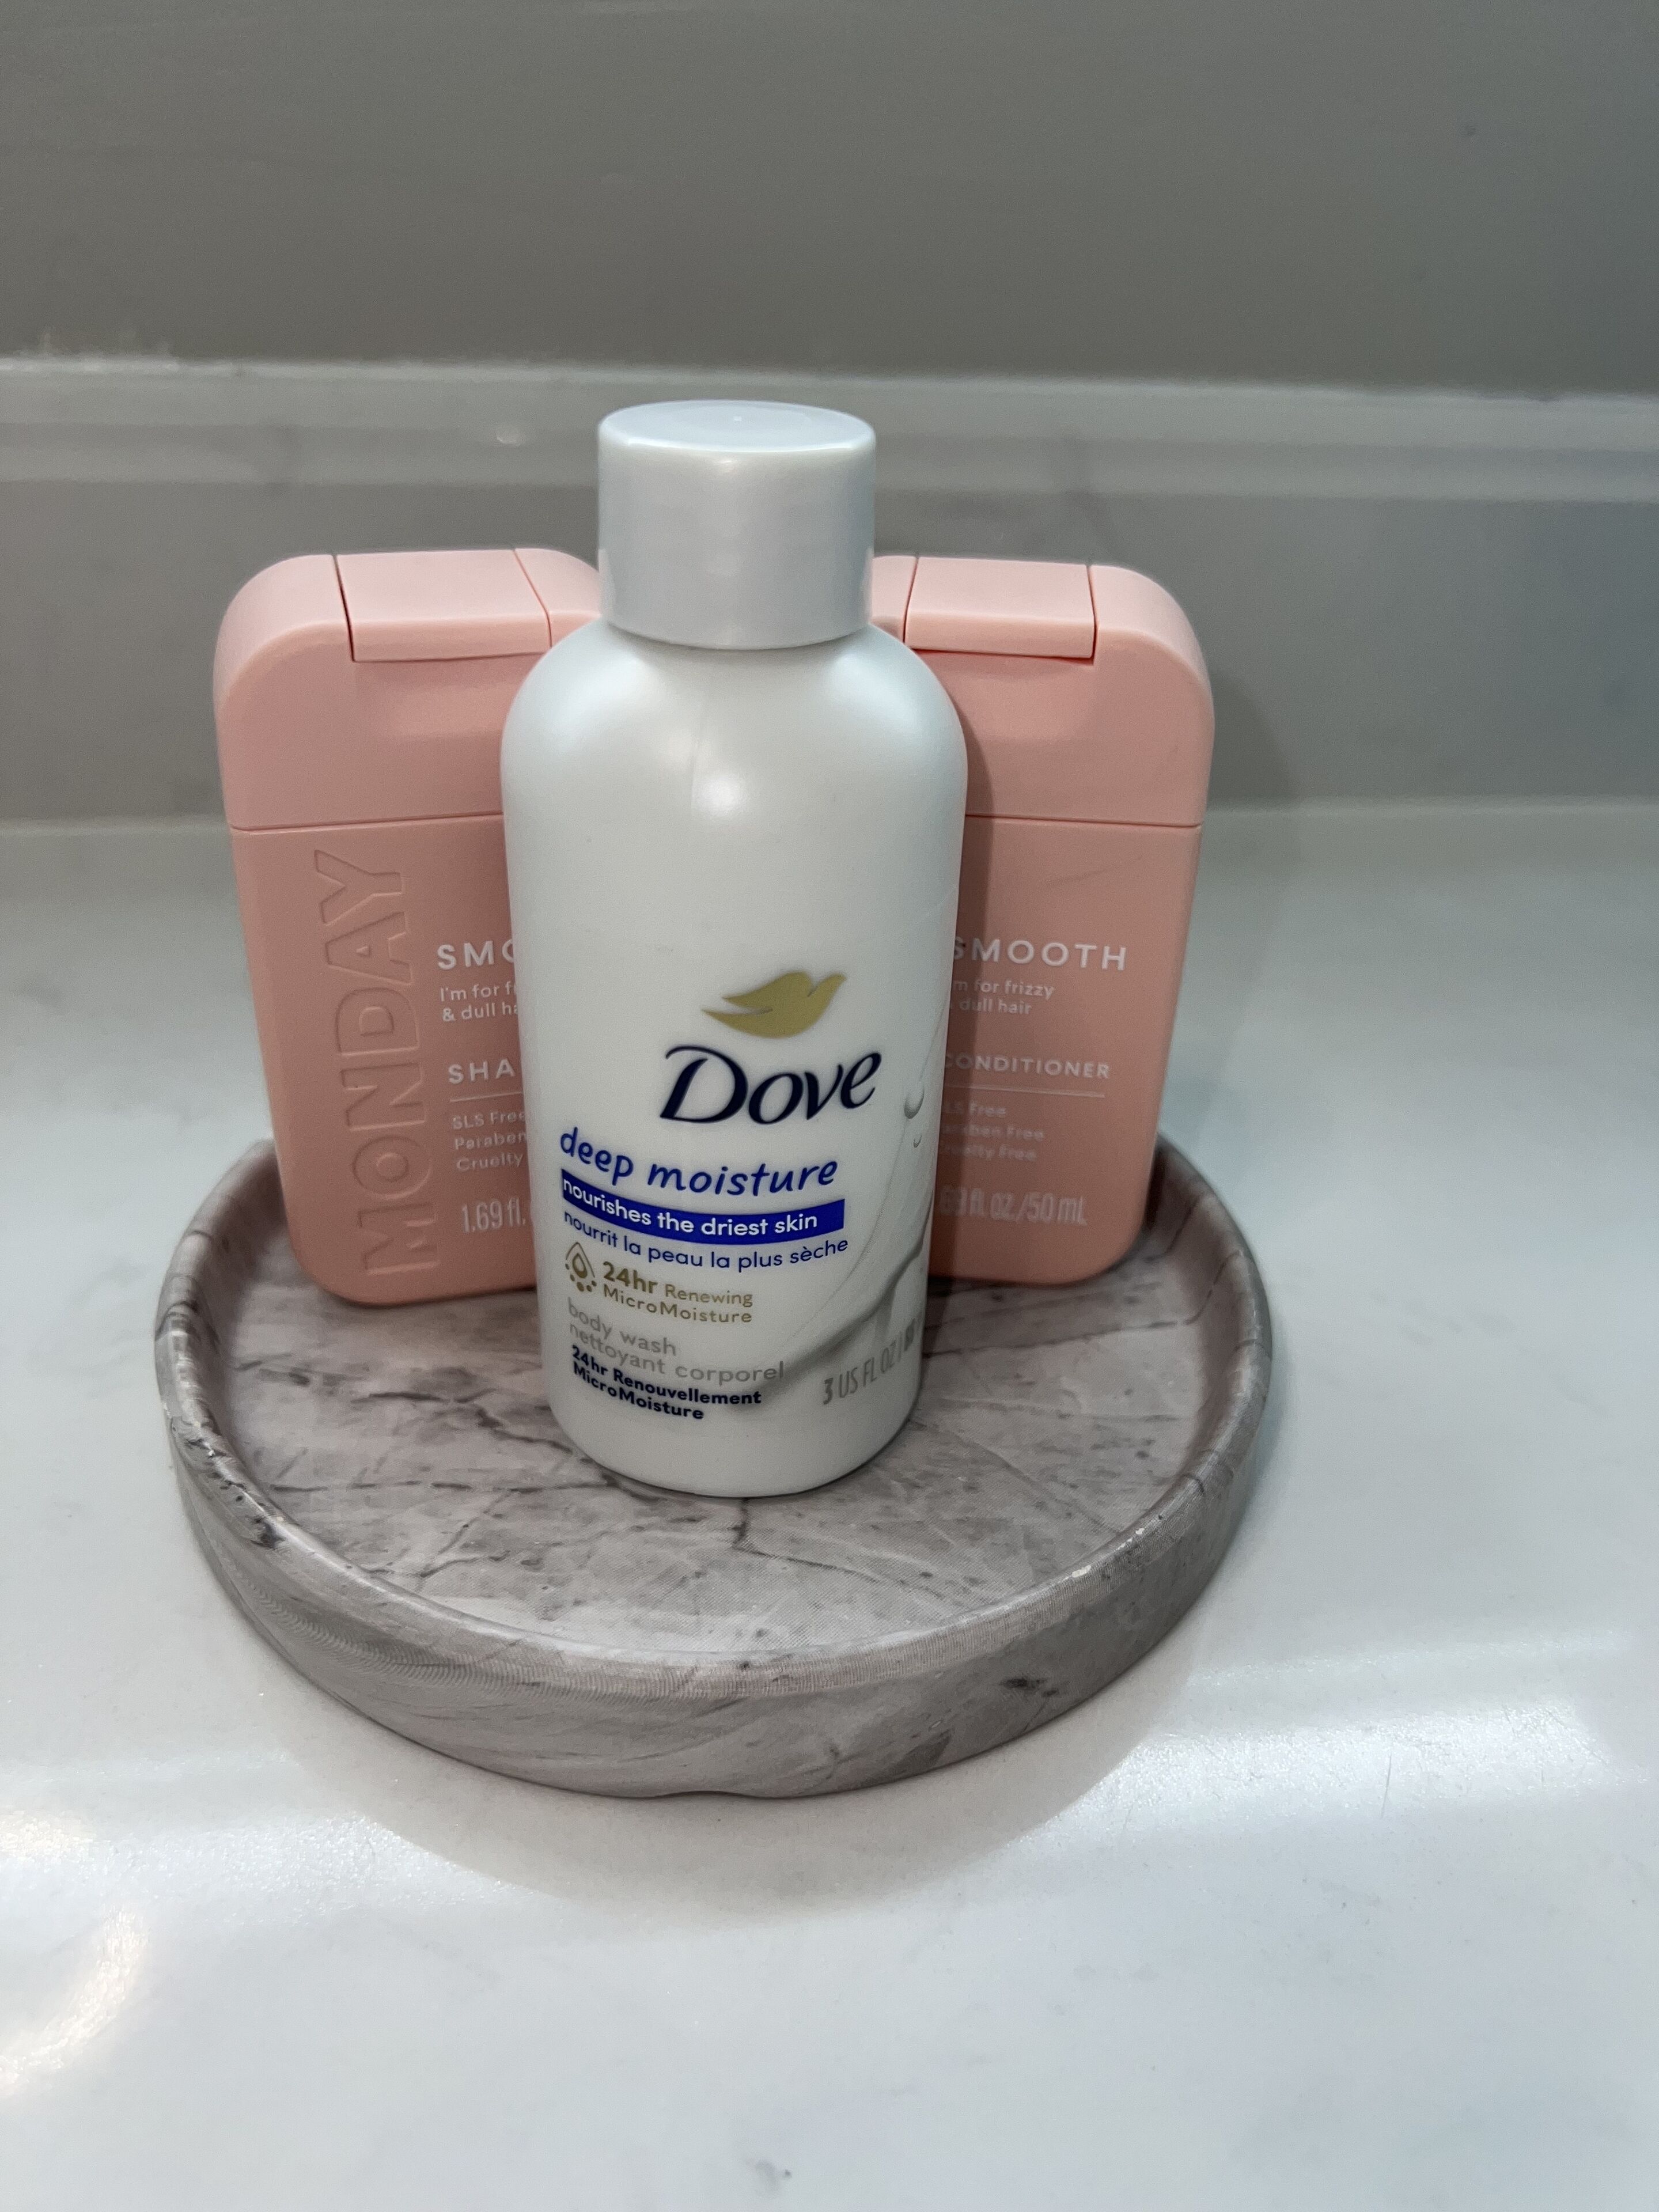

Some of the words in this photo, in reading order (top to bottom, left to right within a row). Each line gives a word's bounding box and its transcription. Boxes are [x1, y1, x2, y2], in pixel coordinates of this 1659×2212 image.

[953, 936, 1127, 971] SMOOTH
[440, 987, 467, 1002] I'm
[472, 983, 500, 999] for
[442, 1007, 456, 1022] &
[461, 1002, 496, 1020] dull
[959, 997, 993, 1013] dull
[998, 1000, 1032, 1015] hair
[974, 980, 1000, 994] for
[1005, 980, 1055, 1001] frizzy
[314, 849, 441, 1275] MONDAY
[659, 1044, 882, 1125] Dove
[452, 1113, 485, 1130] SLS
[454, 1132, 527, 1150] Paraben
[457, 1152, 524, 1172] Cruelty
[560, 1127, 633, 1186] deep
[647, 1160, 838, 1196] moisture
[462, 1199, 503, 1233] 1.69
[563, 1176, 652, 1226] nourishes
[657, 1211, 695, 1233] the
[700, 1216, 769, 1237] driest
[774, 1213, 818, 1234] skin
[564, 1211, 618, 1248] nourrit
[624, 1235, 641, 1256] la
[648, 1245, 703, 1268] peau
[711, 1251, 730, 1268] la
[738, 1251, 783, 1272] plus
[790, 1239, 849, 1264] sèche
[603, 1260, 658, 1294] 24hr
[665, 1283, 753, 1308] Renewing
[603, 1283, 753, 1323] MicroMoisture
[568, 1296, 612, 1339] body
[619, 1331, 677, 1356] wash
[569, 1323, 666, 1375] nettoyant
[675, 1360, 784, 1387] corporel
[572, 1344, 608, 1377] 24hr
[613, 1368, 762, 1404] Renouvellement
[573, 1359, 704, 1420] MicroMoisture
[823, 1377, 834, 1405] 3
[838, 1366, 859, 1399] US
[863, 1357, 878, 1388] FL
